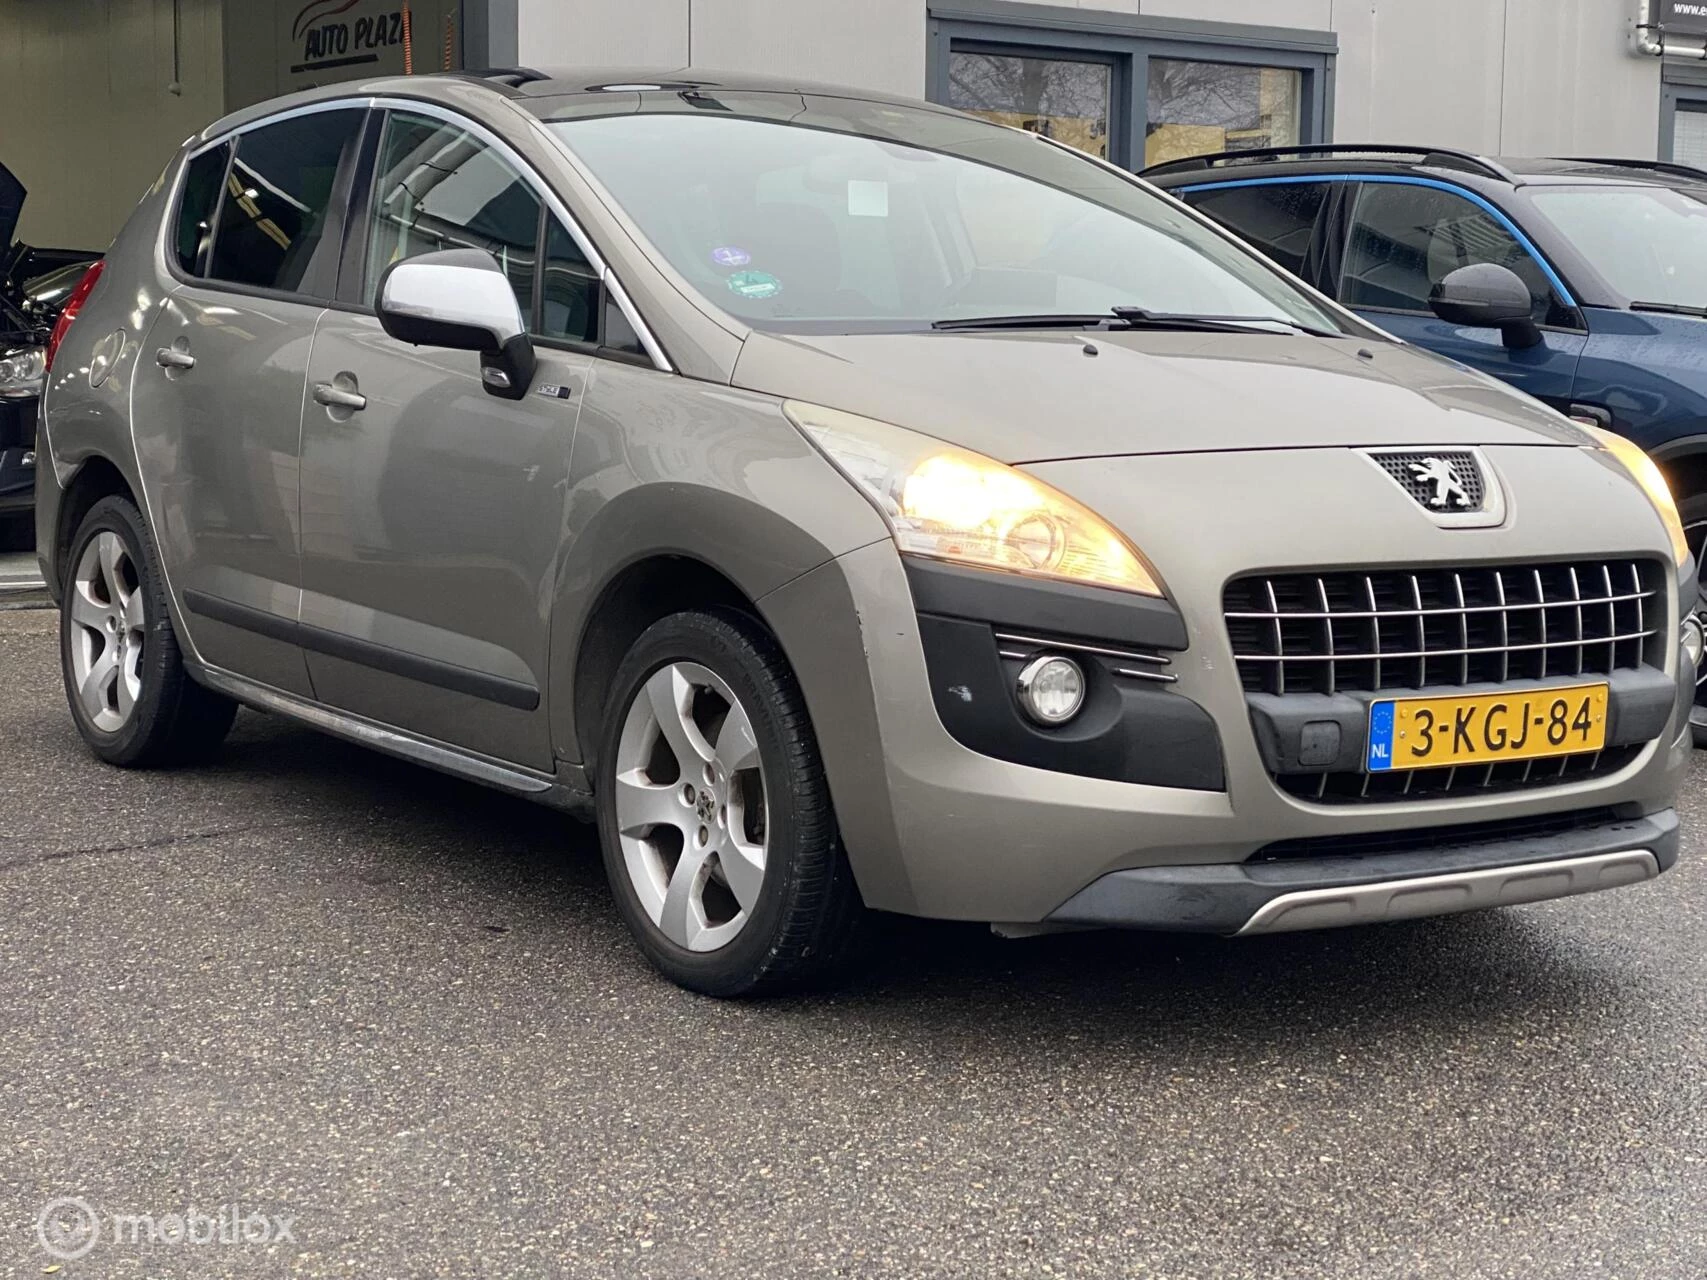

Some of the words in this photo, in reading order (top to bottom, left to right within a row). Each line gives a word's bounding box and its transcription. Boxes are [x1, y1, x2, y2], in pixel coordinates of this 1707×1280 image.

[1674, 3, 1707, 16] www.e
[304, 22, 348, 61] AUTO
[1371, 743, 1389, 759] NL
[1411, 697, 1592, 757] 3-KGJ-84
